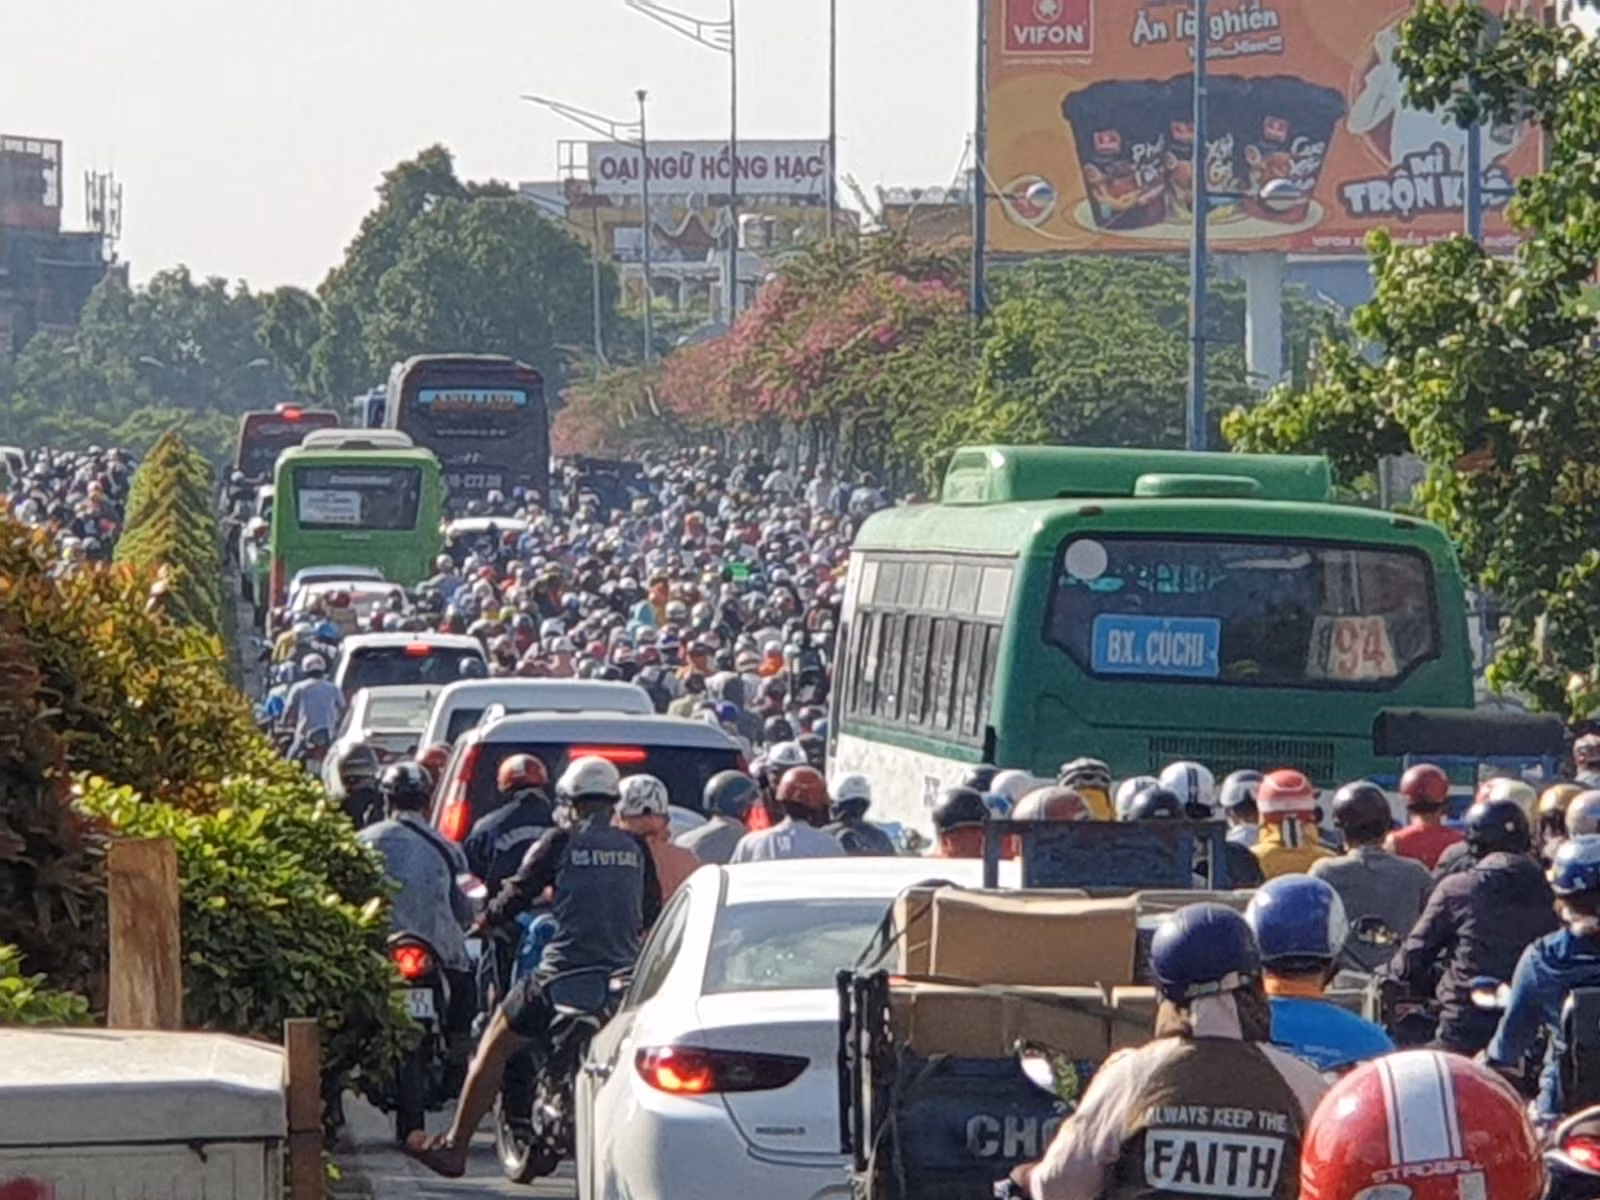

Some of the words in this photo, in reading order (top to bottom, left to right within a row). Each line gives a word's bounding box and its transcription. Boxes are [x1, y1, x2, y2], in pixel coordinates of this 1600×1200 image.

[1012, 25, 1085, 44] VIFON
[1343, 169, 1437, 216] TRỘN
[1335, 619, 1387, 677] 94
[1146, 1104, 1208, 1127] ALWAYS
[1212, 1108, 1254, 1129] KEEP
[1258, 1110, 1288, 1132] THE
[1153, 1139, 1276, 1190] FAITH
